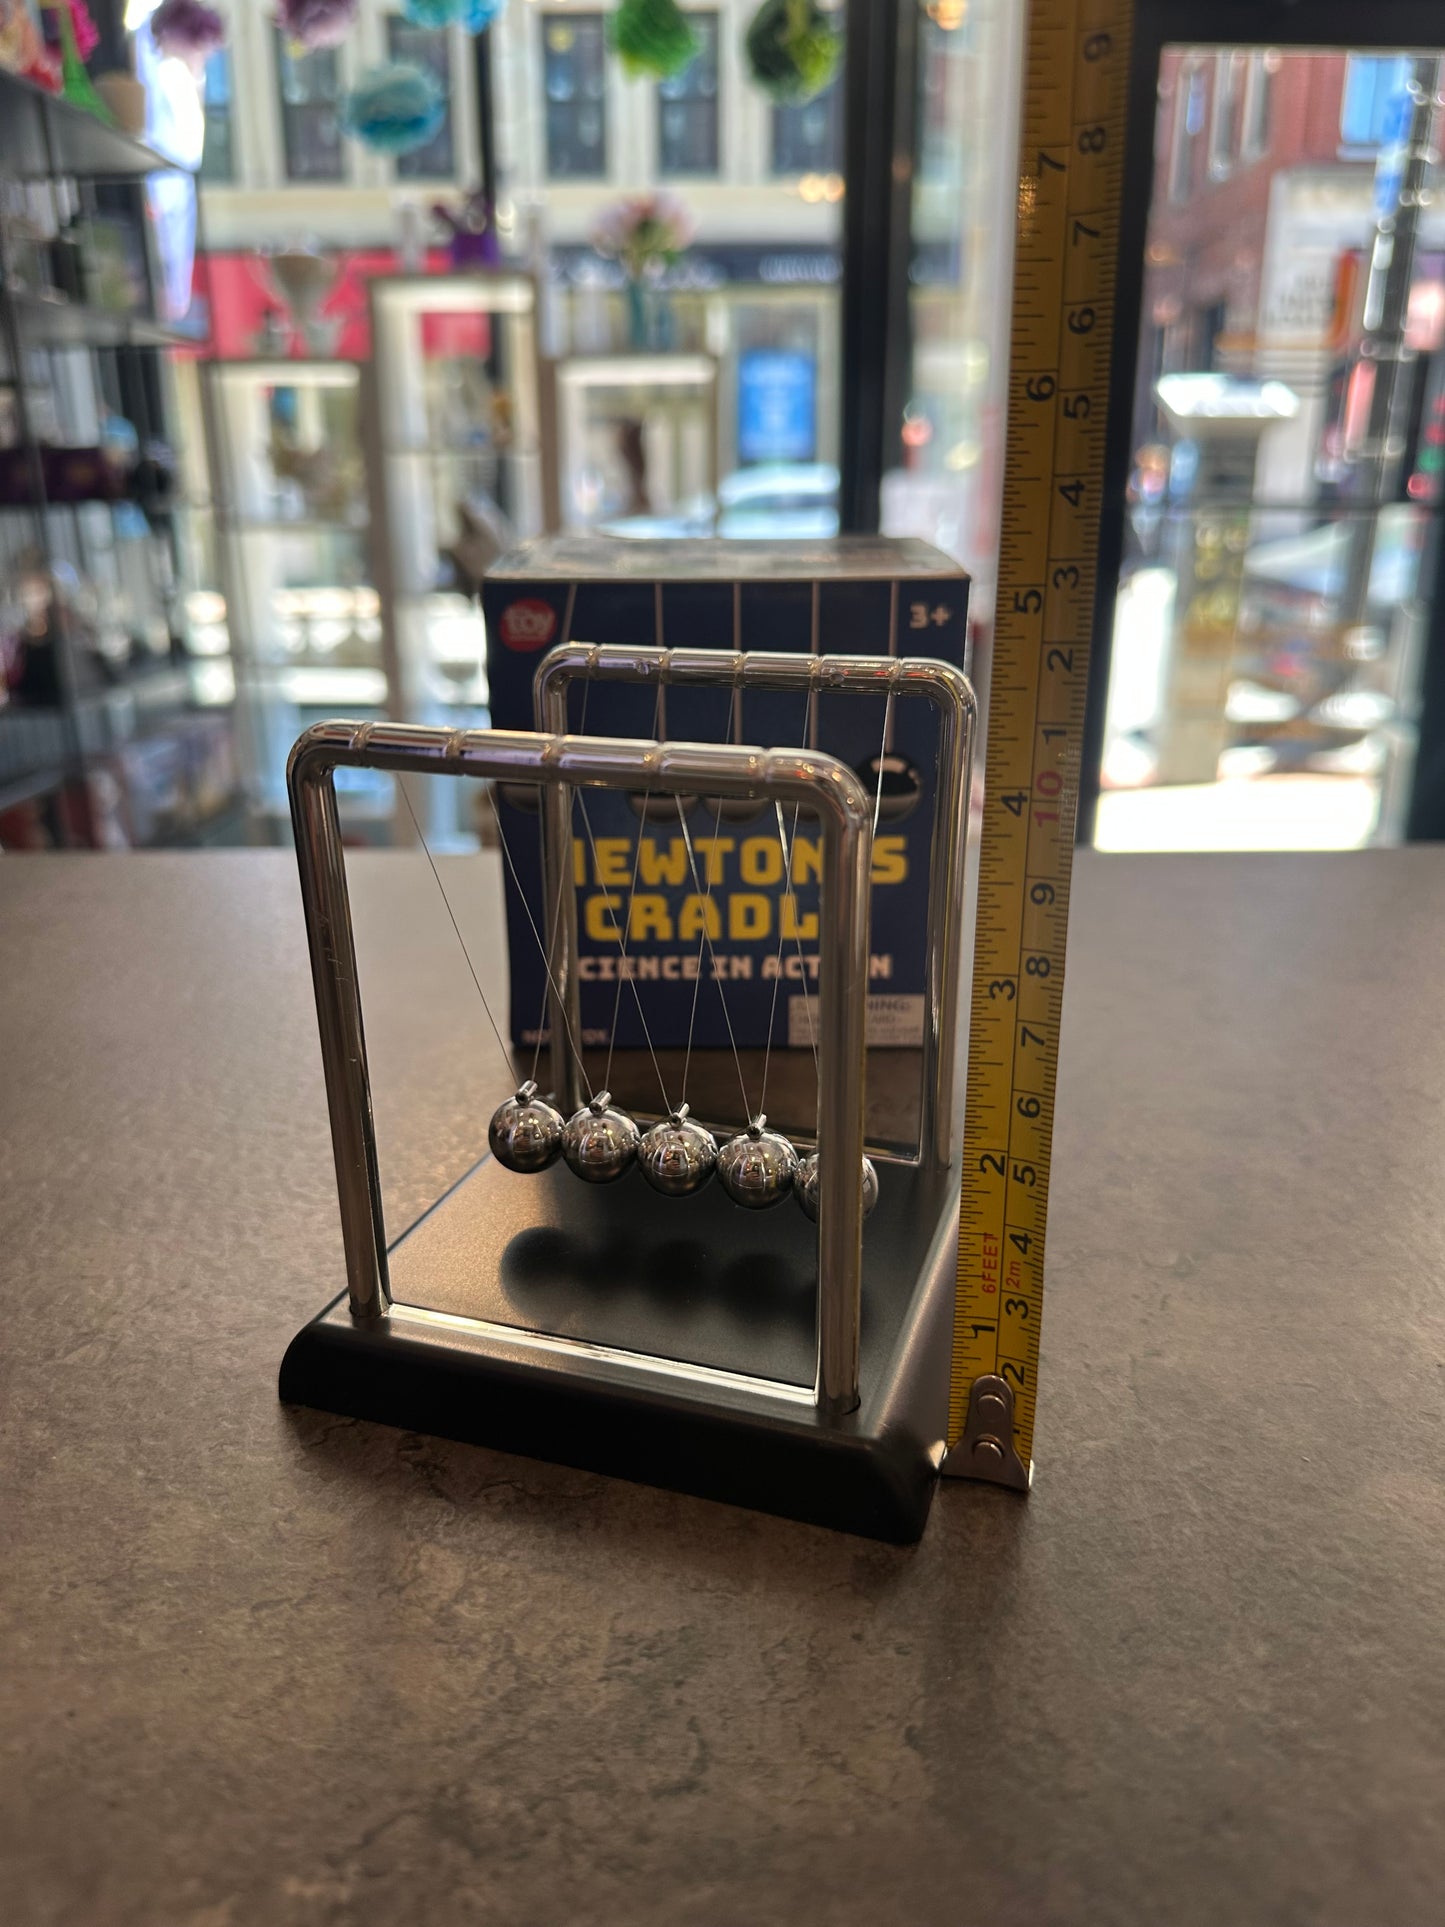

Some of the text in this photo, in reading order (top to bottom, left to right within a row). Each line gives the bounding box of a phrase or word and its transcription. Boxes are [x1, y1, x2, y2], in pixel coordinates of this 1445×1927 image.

[1083, 32, 1112, 62] 9
[1078, 126, 1106, 155] 8
[1035, 152, 1067, 179] 7
[1073, 220, 1100, 246] 7
[1068, 306, 1096, 334] 6
[1026, 375, 1056, 401] 6
[1064, 395, 1091, 419] 5
[1059, 480, 1085, 506] 4
[1053, 566, 1079, 589] 3
[1013, 589, 1042, 614] 5
[910, 604, 950, 628] 3+
[1046, 649, 1073, 672] 2
[1042, 729, 1067, 744] 1
[1001, 791, 1028, 816] 4
[1034, 770, 1063, 828] 10
[575, 837, 908, 886] EWTONS
[1030, 883, 1055, 905] 9
[585, 893, 820, 941] CRADL
[579, 956, 893, 980] CIENCE IN ACTN
[1026, 956, 1051, 978] 8
[989, 979, 1016, 1001] 3
[1021, 1026, 1045, 1048] 7
[1017, 1096, 1041, 1118] 6
[979, 1153, 1005, 1176] 2
[1013, 1164, 1037, 1187] 5
[1009, 1232, 1033, 1255] 4
[981, 1232, 999, 1294] 6FEET
[1005, 1260, 1022, 1289] 2m
[1005, 1297, 1029, 1320] 3
[971, 1323, 995, 1339] 1
[1001, 1362, 1024, 1385] 2
